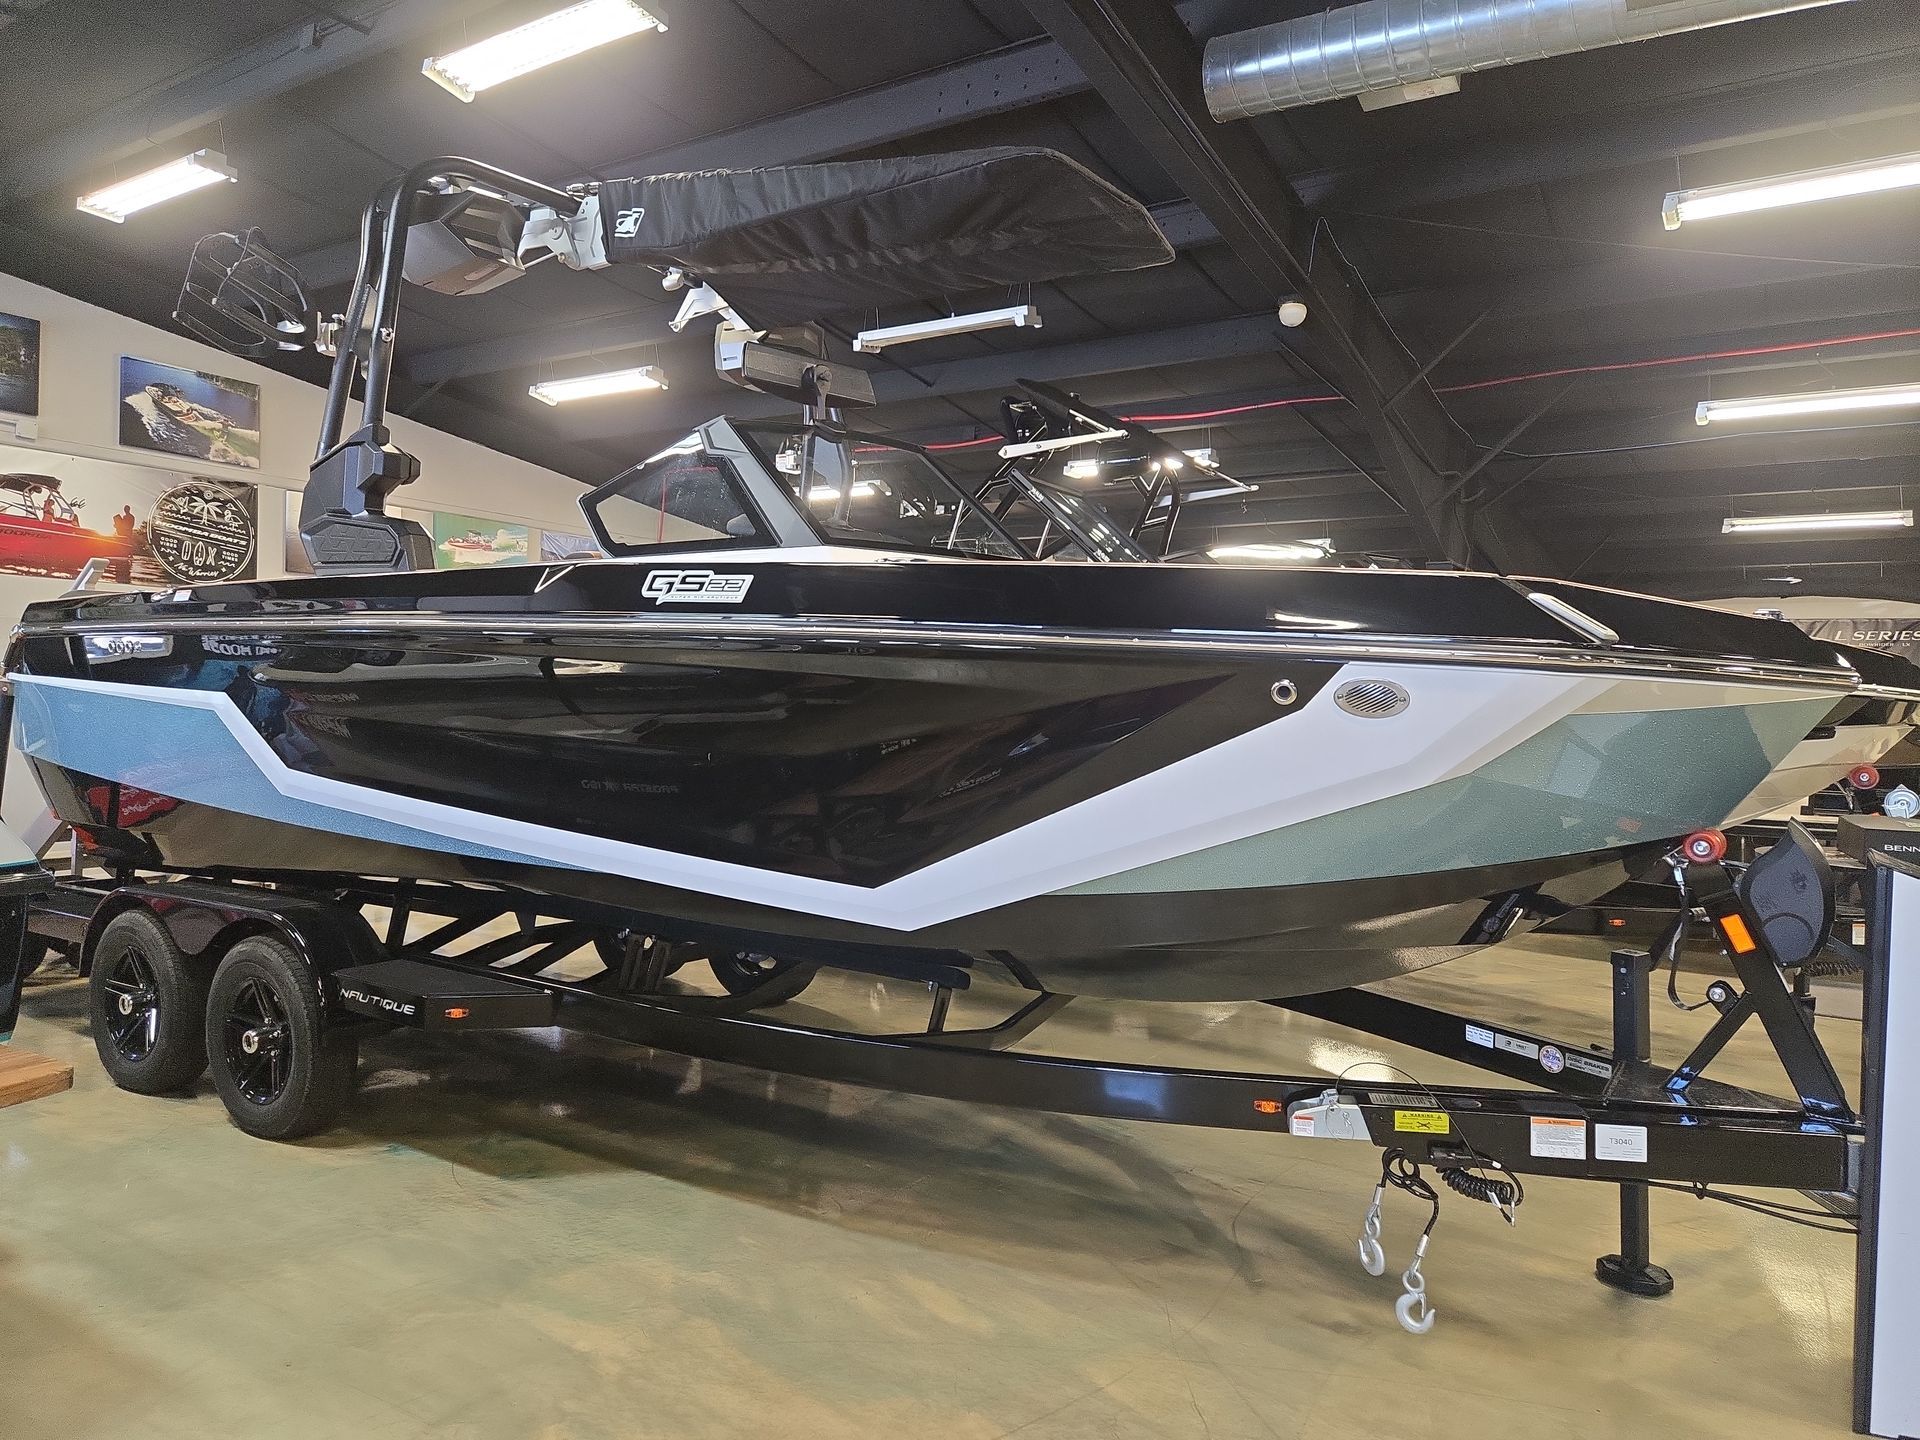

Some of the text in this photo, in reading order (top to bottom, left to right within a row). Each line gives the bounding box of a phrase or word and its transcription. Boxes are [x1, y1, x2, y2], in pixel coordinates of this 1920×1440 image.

[0, 528, 48, 539] OOMBA
[155, 520, 248, 546] MOOMBA BOATS
[160, 536, 178, 544] GOOD
[222, 550, 239, 558] GOOD
[1834, 630, 1920, 641] L SERIES
[340, 988, 416, 1015] NAUTIQUE
[1609, 1137, 1633, 1146] T3040
